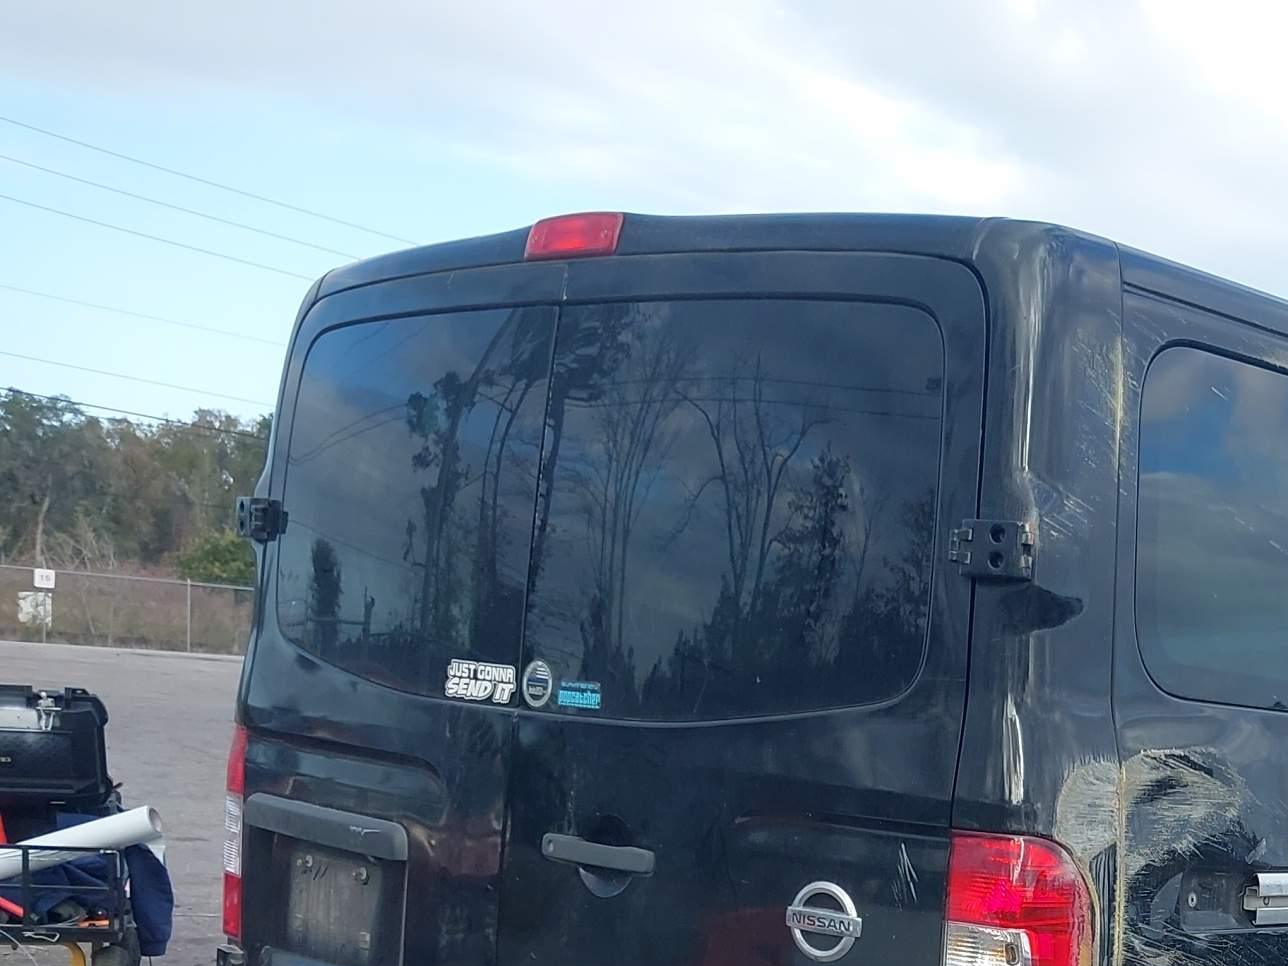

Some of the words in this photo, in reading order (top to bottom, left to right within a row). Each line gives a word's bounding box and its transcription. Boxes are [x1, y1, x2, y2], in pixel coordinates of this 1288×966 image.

[449, 661, 475, 679] JUST
[477, 666, 514, 683] GONNA
[447, 677, 493, 700] SEND
[495, 681, 515, 702] IT
[791, 911, 850, 932] NISSAN
